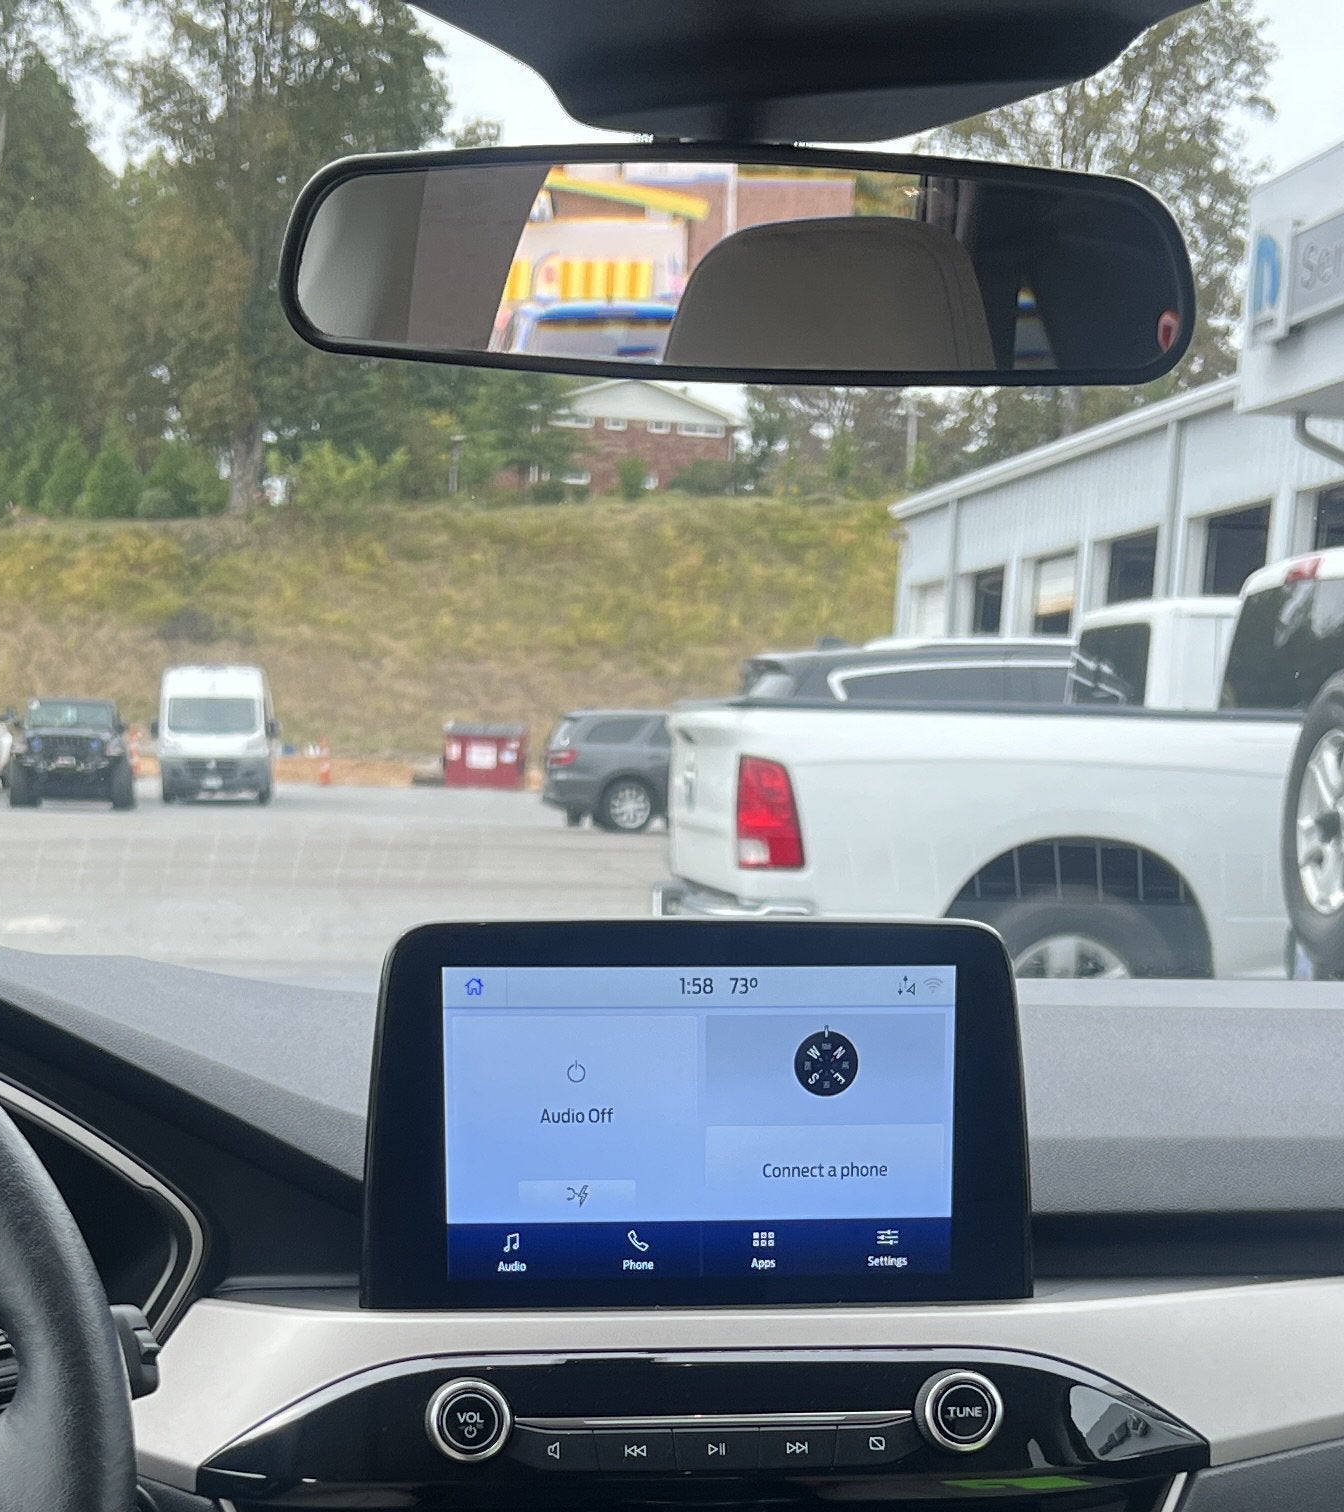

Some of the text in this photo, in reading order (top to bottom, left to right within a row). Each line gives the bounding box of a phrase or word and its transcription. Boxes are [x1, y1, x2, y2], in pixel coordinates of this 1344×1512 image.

[679, 977, 714, 995] 1:58
[540, 1107, 614, 1124] Audio Off
[762, 1161, 888, 1181] Connect a phone
[497, 1260, 527, 1273] Audio
[622, 1259, 654, 1271] Phone
[751, 1257, 776, 1270] Apps
[867, 1255, 908, 1268] Settings
[456, 1412, 485, 1424] VOL
[947, 1406, 983, 1418] TUNE
